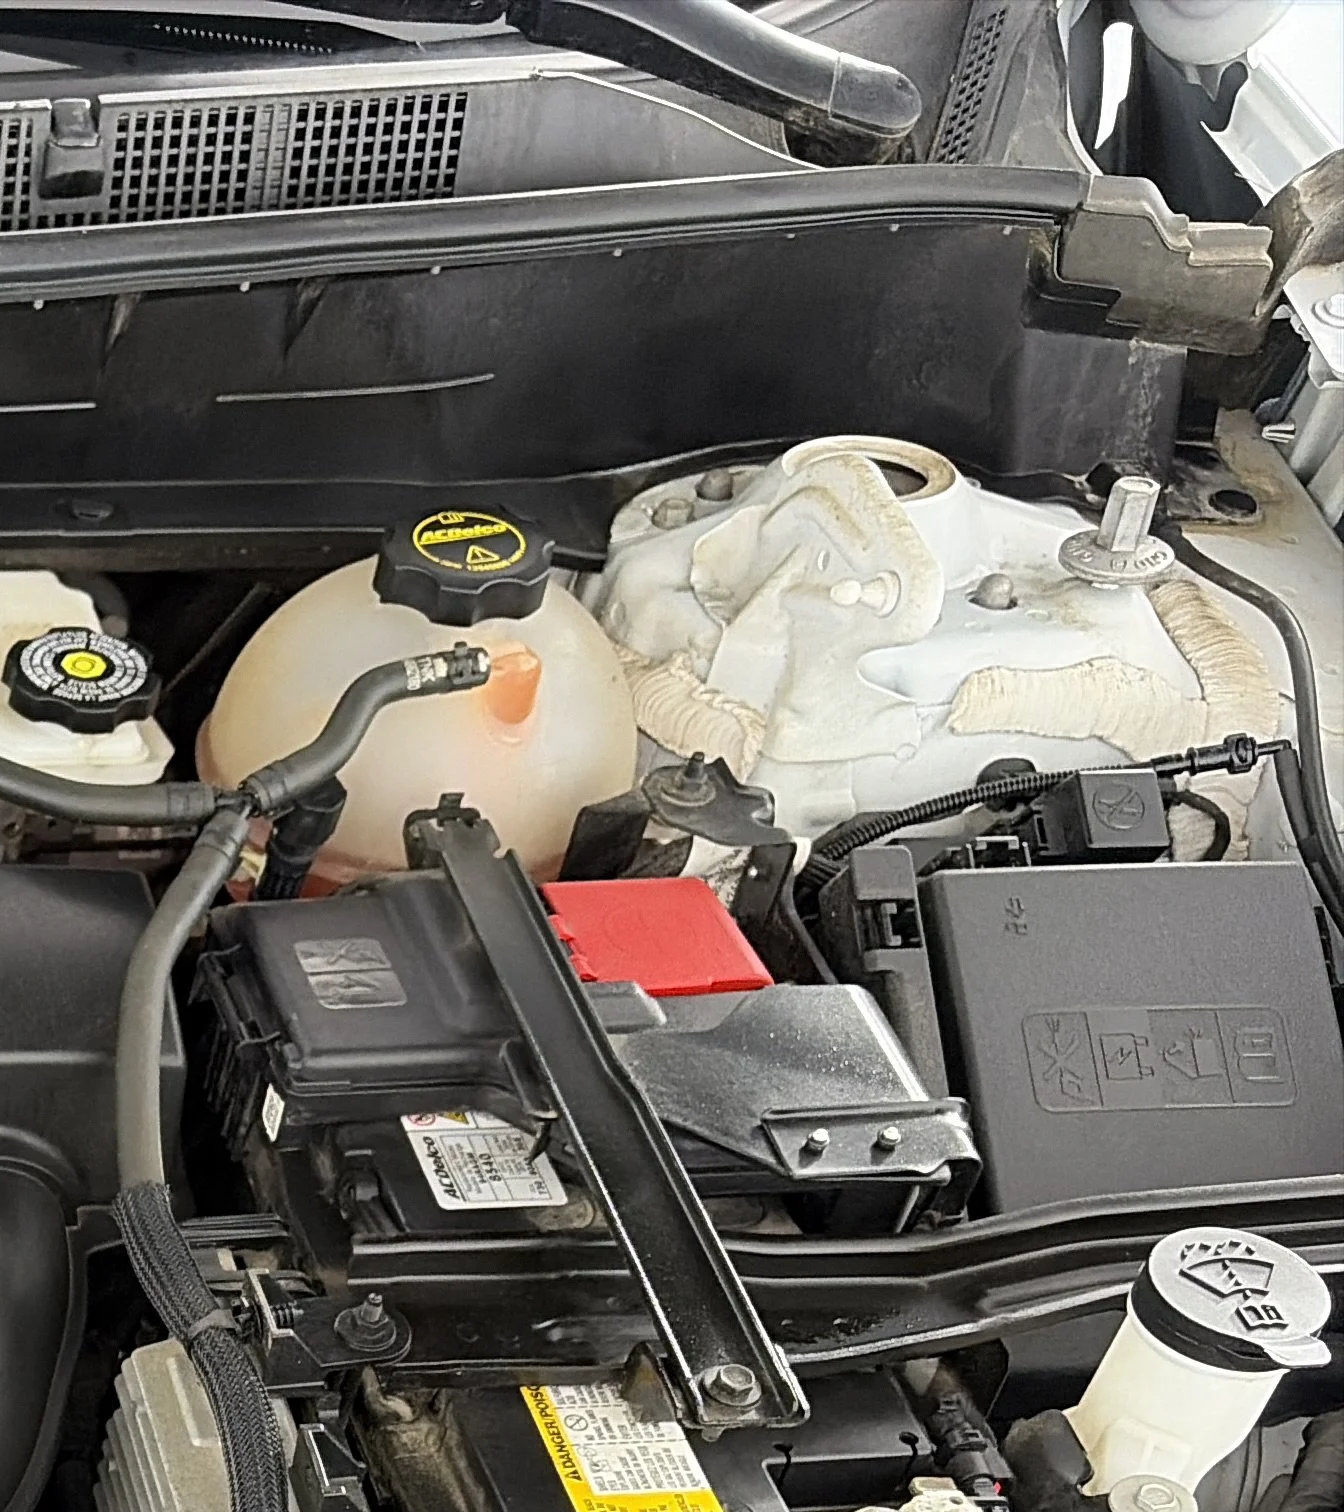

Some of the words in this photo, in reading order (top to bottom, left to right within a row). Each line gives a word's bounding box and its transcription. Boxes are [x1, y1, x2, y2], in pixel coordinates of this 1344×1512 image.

[421, 523, 509, 543] ACDelco
[423, 1136, 461, 1200] ACDelco
[527, 1384, 576, 1468] DANGER/POISO
